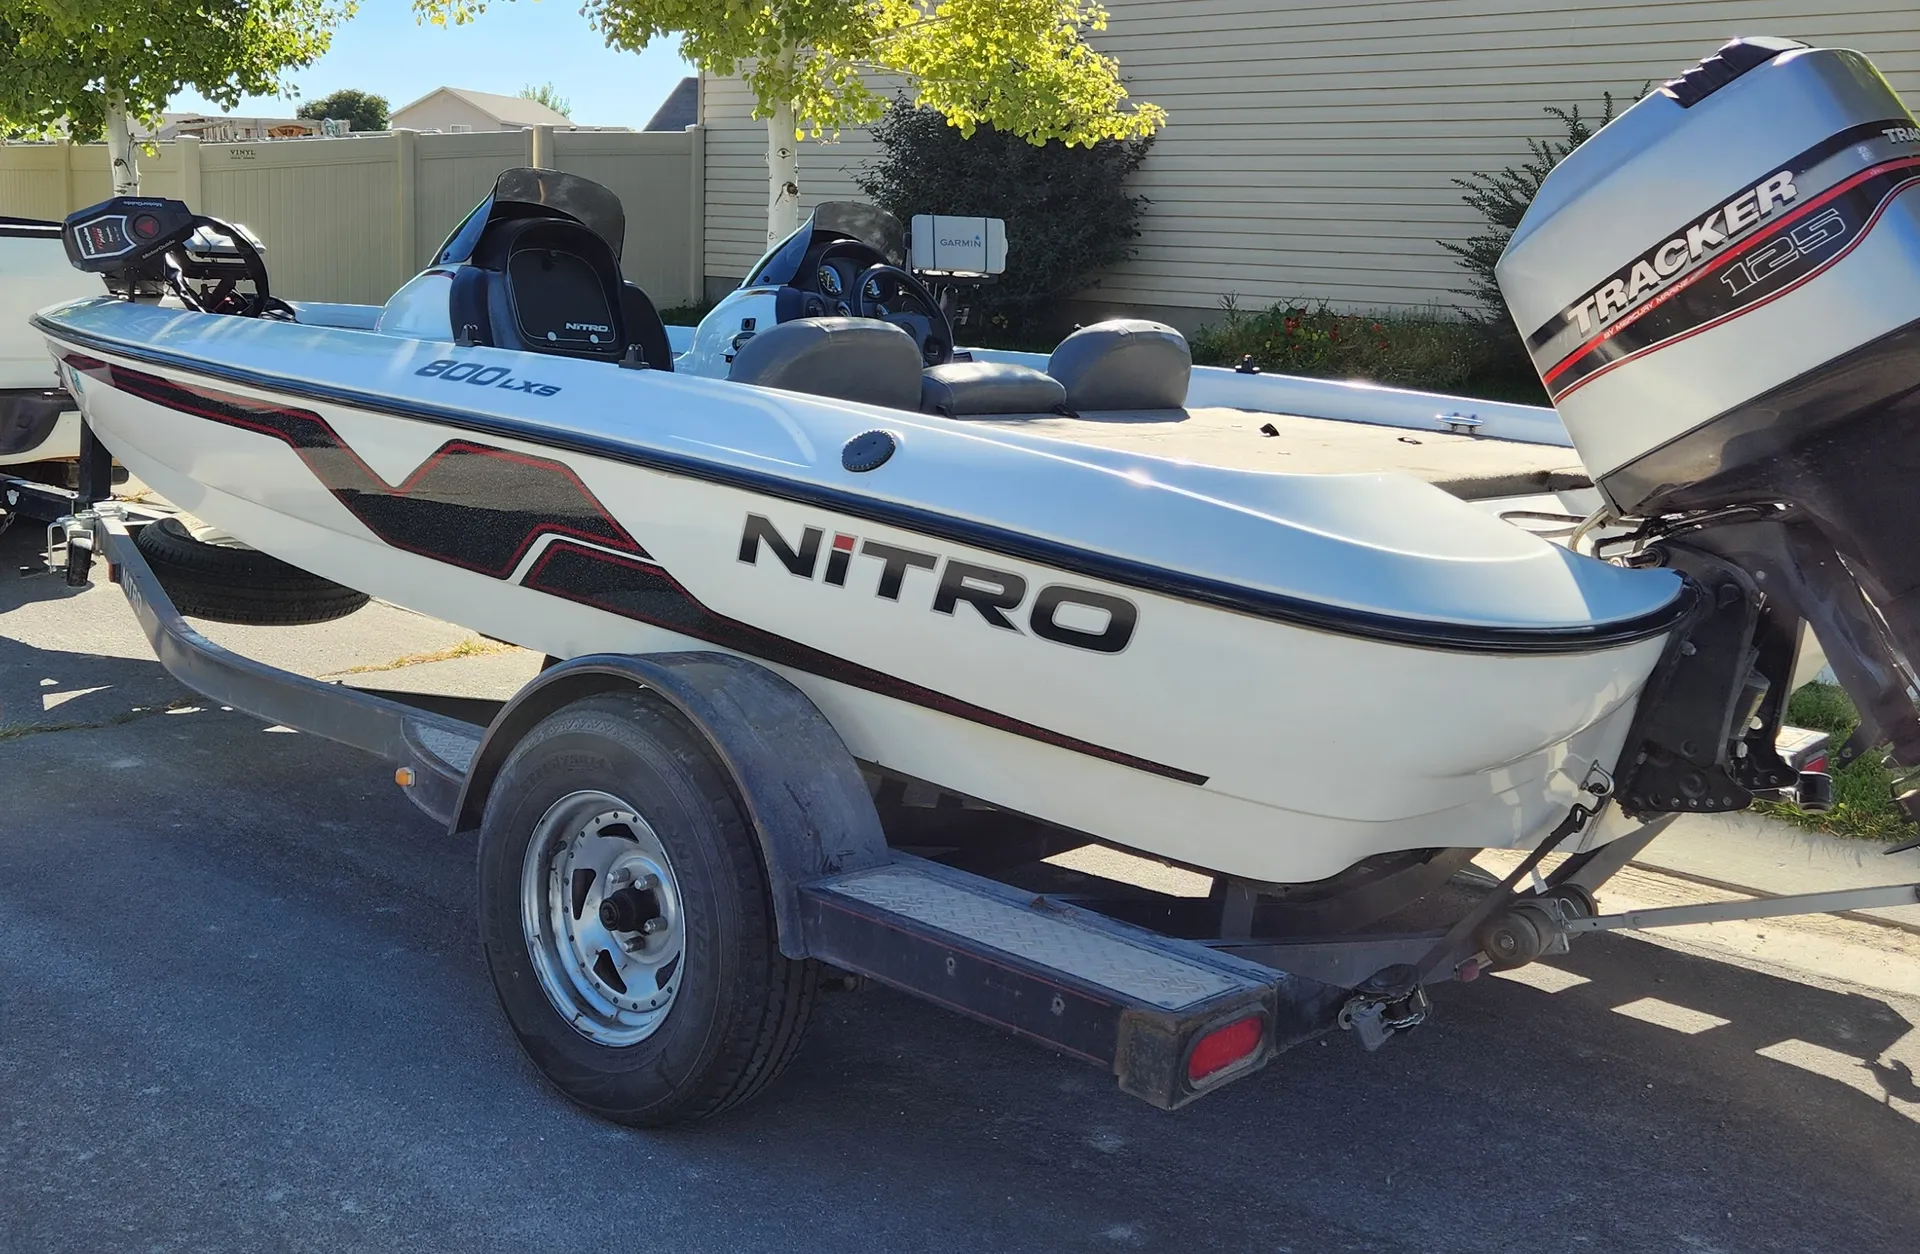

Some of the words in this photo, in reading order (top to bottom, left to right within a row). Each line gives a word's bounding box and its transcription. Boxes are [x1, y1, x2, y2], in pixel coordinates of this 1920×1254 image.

[142, 240, 175, 259] MotorGuide
[940, 239, 982, 248] GARMIN
[1567, 170, 1798, 335] TRACKER
[1719, 208, 1846, 297] 125
[1603, 329, 1615, 339] BY
[1615, 301, 1655, 330] MERCURY
[414, 359, 512, 386] 800
[495, 378, 562, 397] LXS
